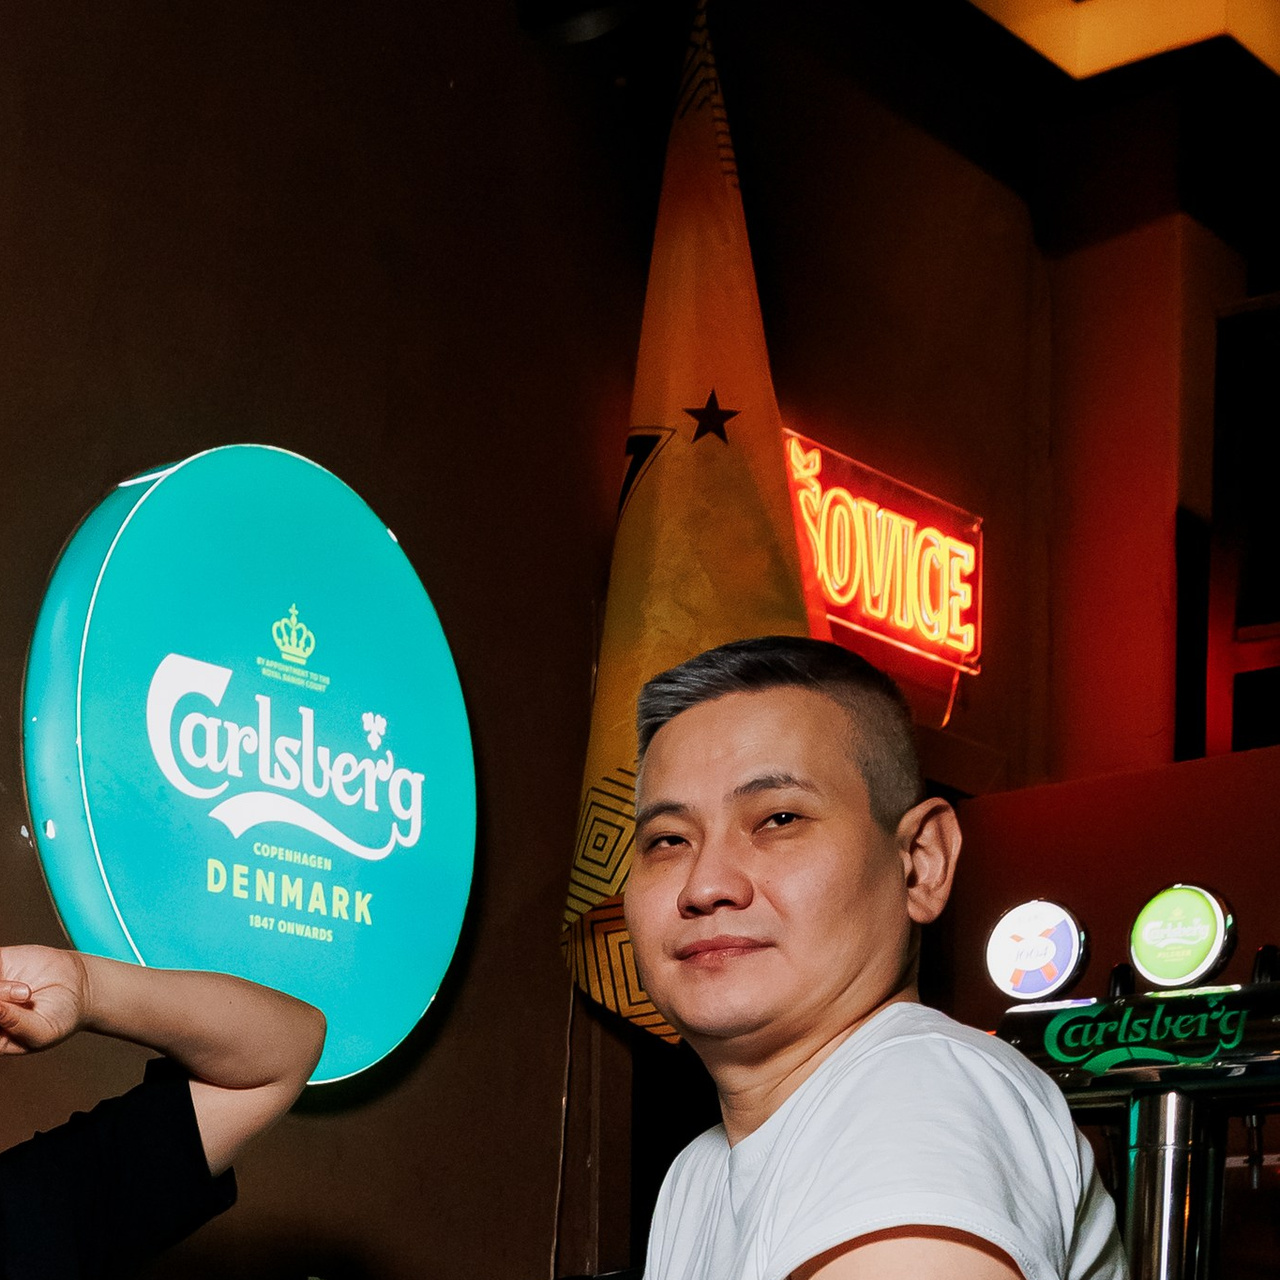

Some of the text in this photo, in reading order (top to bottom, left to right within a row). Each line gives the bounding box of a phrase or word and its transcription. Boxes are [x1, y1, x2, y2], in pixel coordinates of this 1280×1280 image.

[146, 652, 425, 851] Carlsberg
[252, 841, 333, 872] COPENHAGEN
[206, 857, 374, 926] DENMARK
[248, 914, 334, 943] 1847 ONWARDS
[1142, 920, 1210, 946] Carlsberg
[1043, 1003, 1249, 1064] Carlsberg
